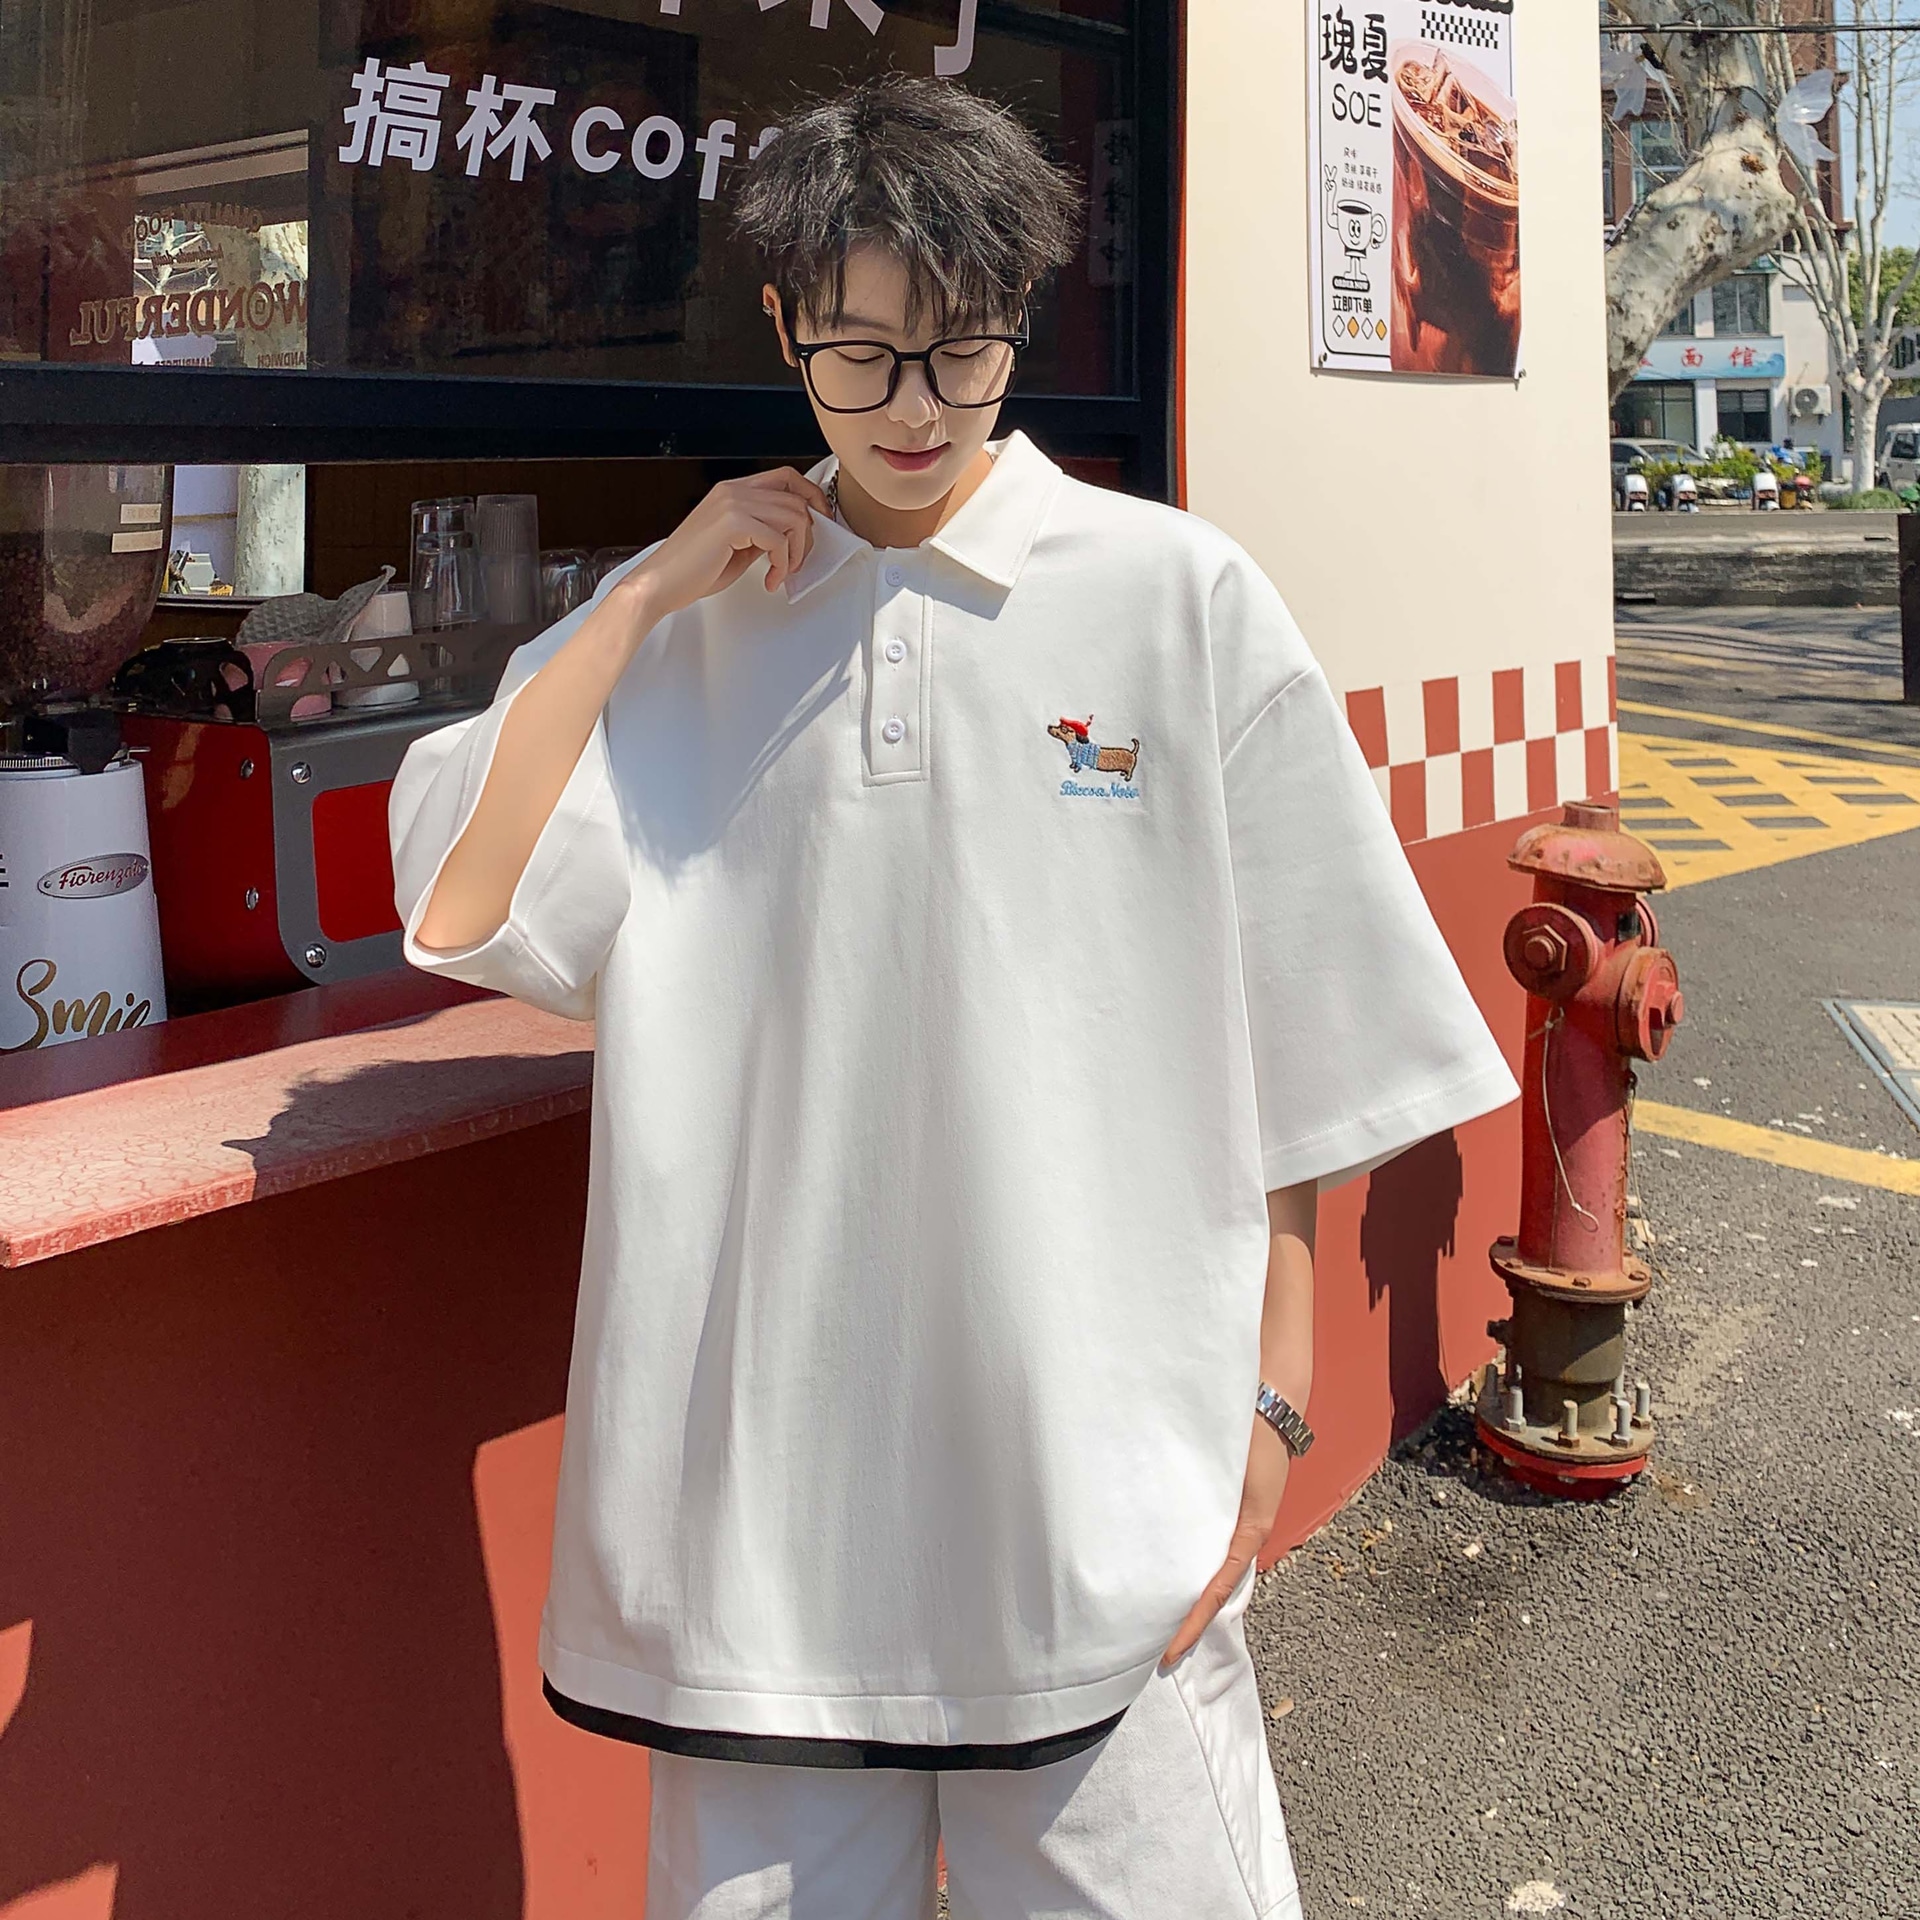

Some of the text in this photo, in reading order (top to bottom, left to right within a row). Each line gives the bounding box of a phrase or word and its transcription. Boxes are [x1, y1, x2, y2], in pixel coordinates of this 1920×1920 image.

[1320, 3, 1389, 84] 瑰夏
[338, 57, 557, 182] 搞杯
[1332, 83, 1381, 128] SOE
[1332, 294, 1373, 314] 立即下单
[58, 860, 143, 890] Fiorenzato
